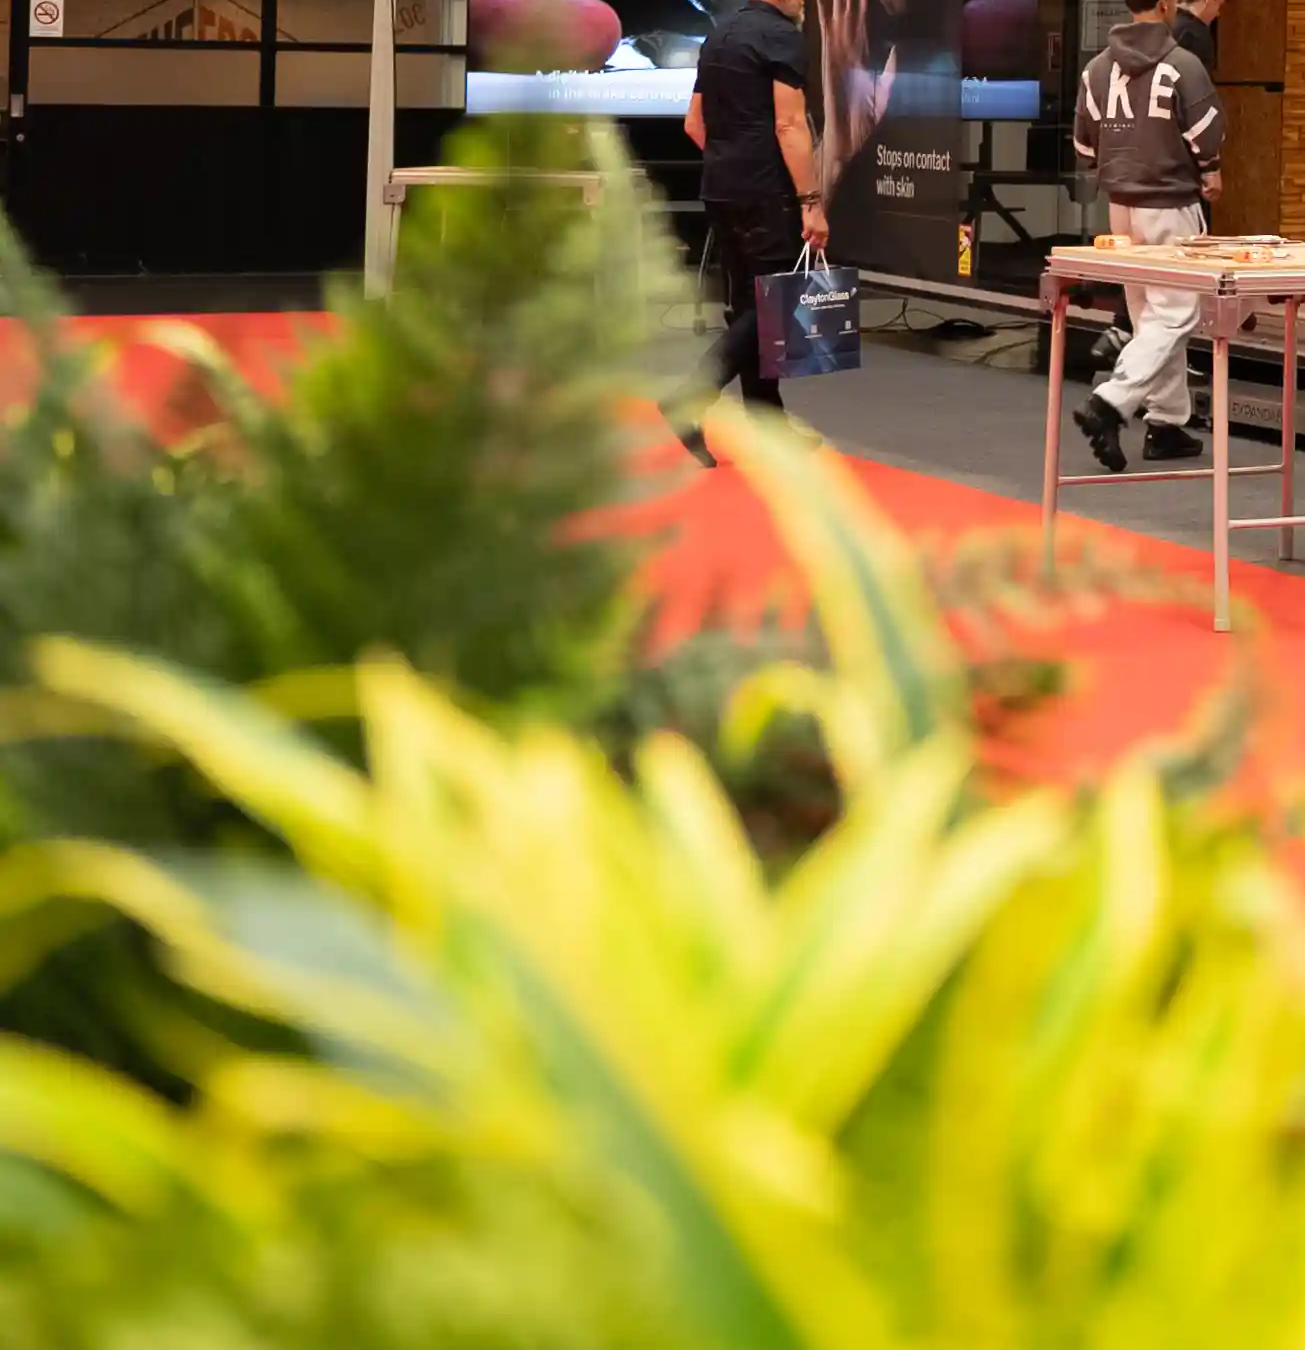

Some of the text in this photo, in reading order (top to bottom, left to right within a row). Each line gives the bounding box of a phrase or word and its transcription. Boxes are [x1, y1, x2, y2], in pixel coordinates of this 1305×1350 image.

[876, 143, 951, 171] Stops on contact
[876, 174, 915, 199] with skin
